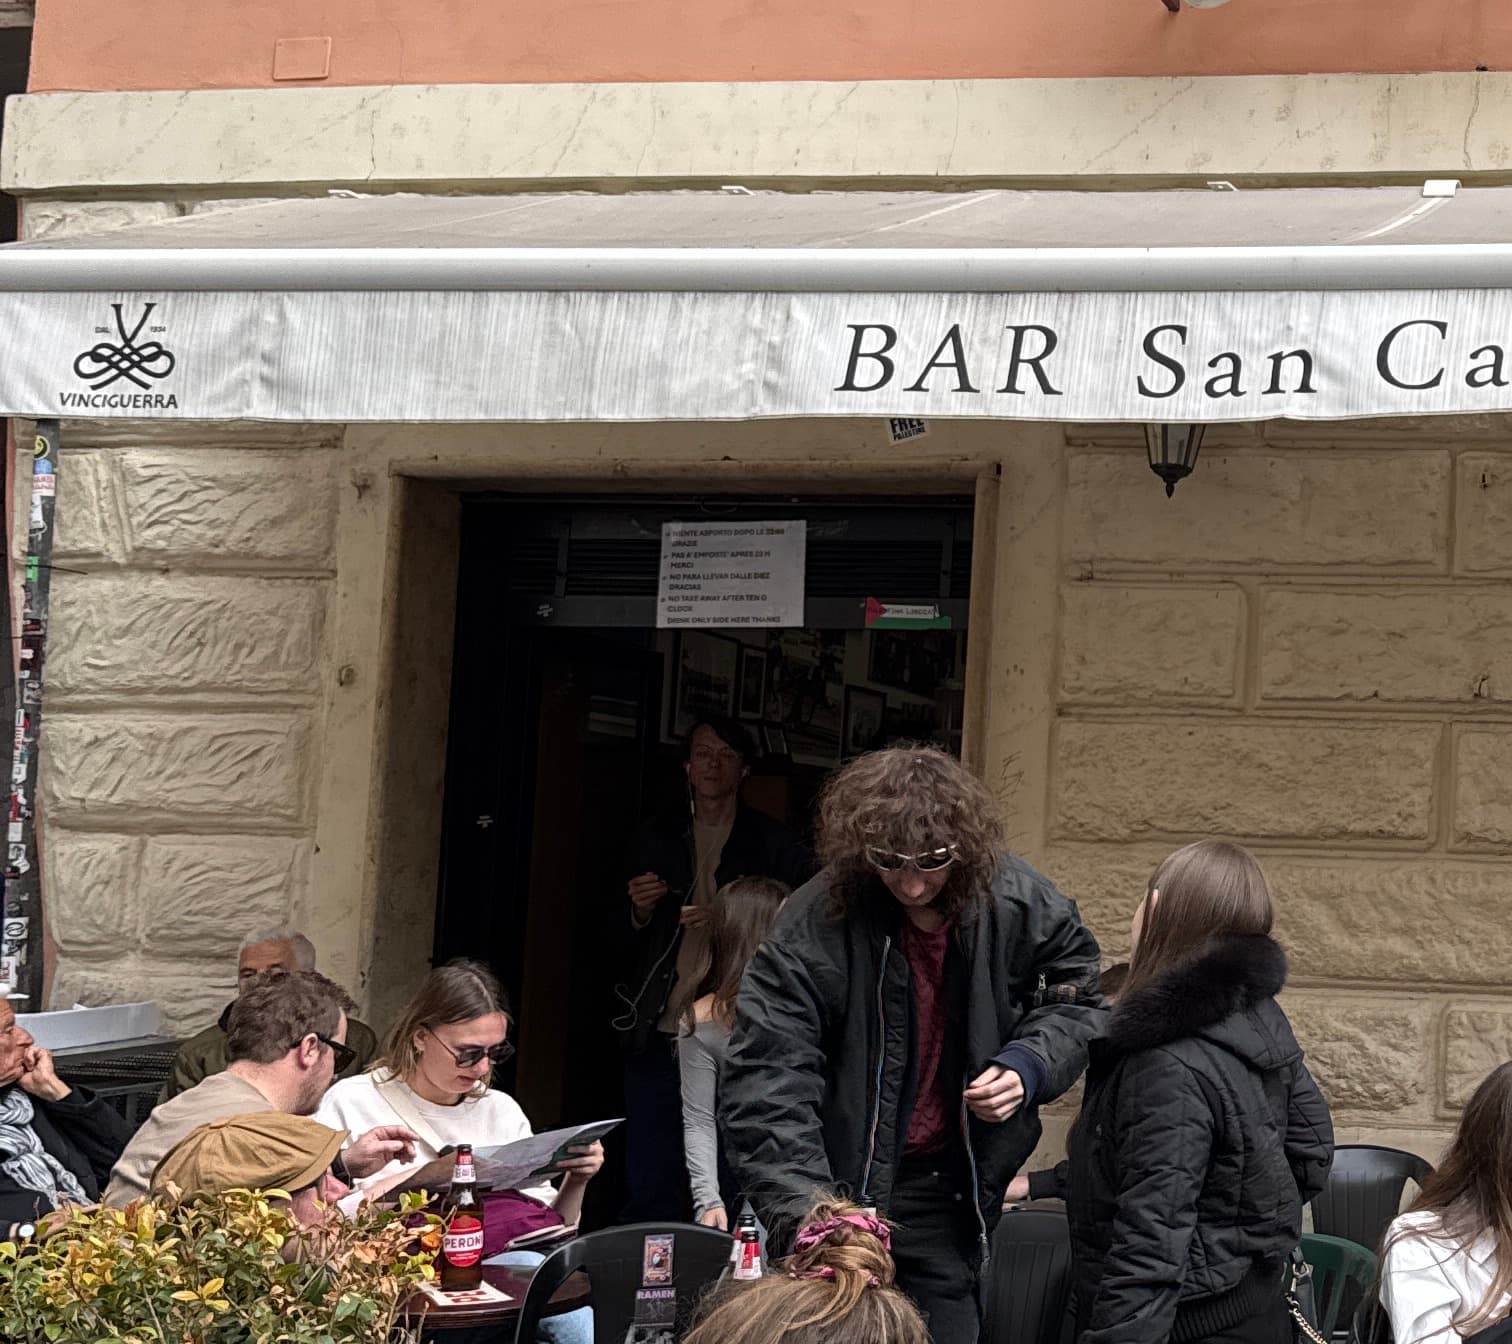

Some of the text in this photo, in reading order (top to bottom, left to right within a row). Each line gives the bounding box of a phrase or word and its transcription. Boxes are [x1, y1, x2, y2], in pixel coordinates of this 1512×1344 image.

[833, 323, 1063, 396] BAR
[1136, 324, 1317, 399] San
[59, 392, 178, 409] VINCIGUERRA
[444, 1233, 482, 1249] PERON
